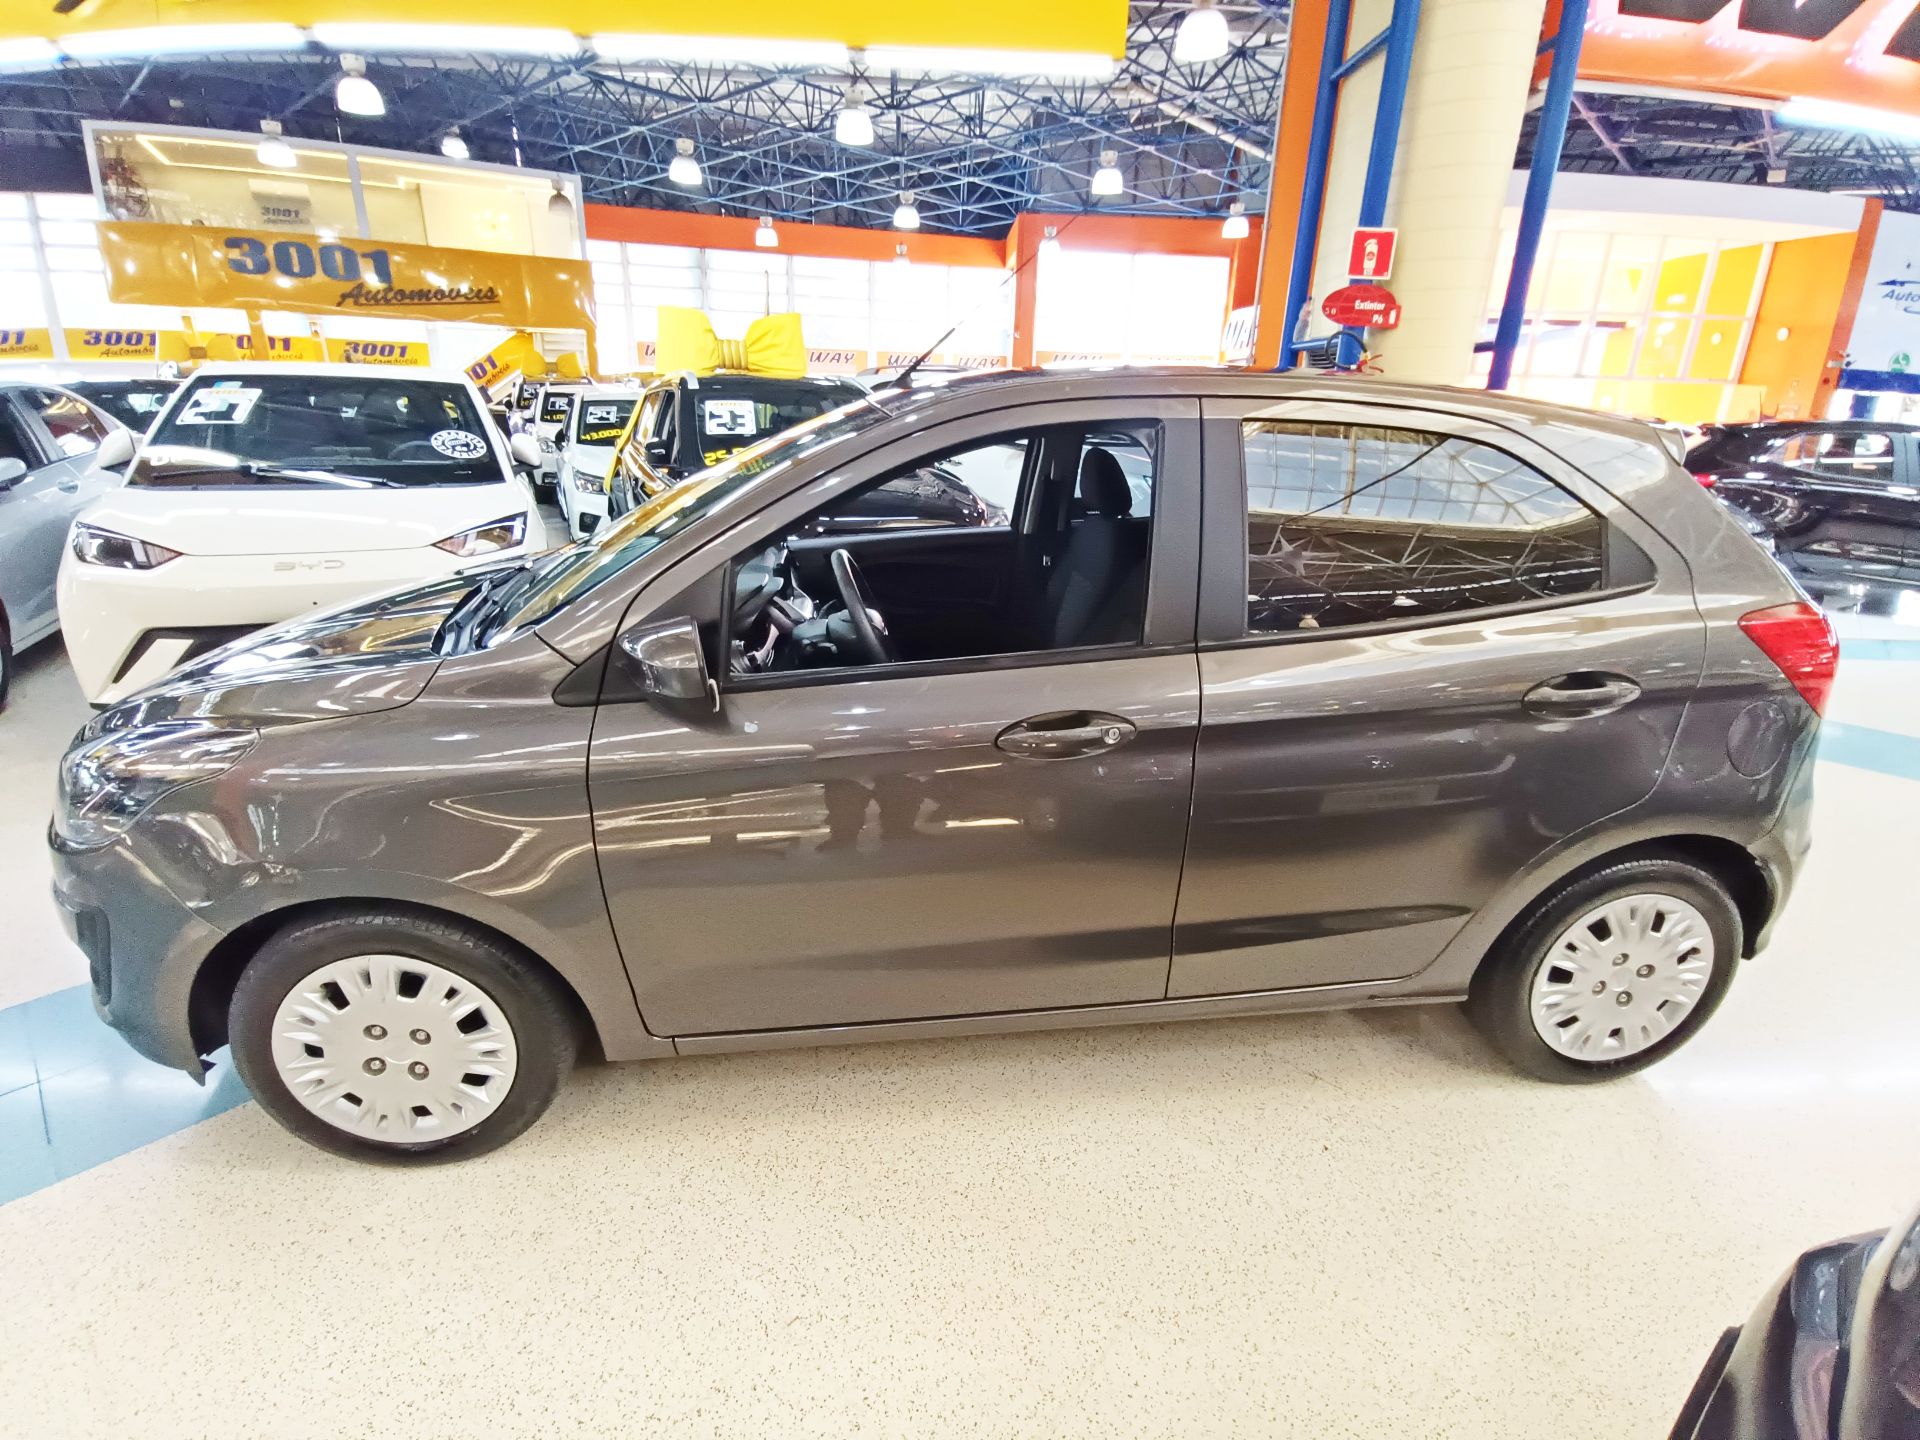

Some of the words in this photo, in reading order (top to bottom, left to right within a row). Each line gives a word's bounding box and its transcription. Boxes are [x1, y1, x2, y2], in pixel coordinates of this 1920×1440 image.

[224, 237, 392, 285] 3001
[1354, 299, 1386, 311] Extintor
[83, 330, 156, 346] 3001
[344, 341, 408, 358] 3001
[810, 351, 855, 364] WAY
[707, 408, 754, 433] 23
[273, 559, 345, 572] BYD
